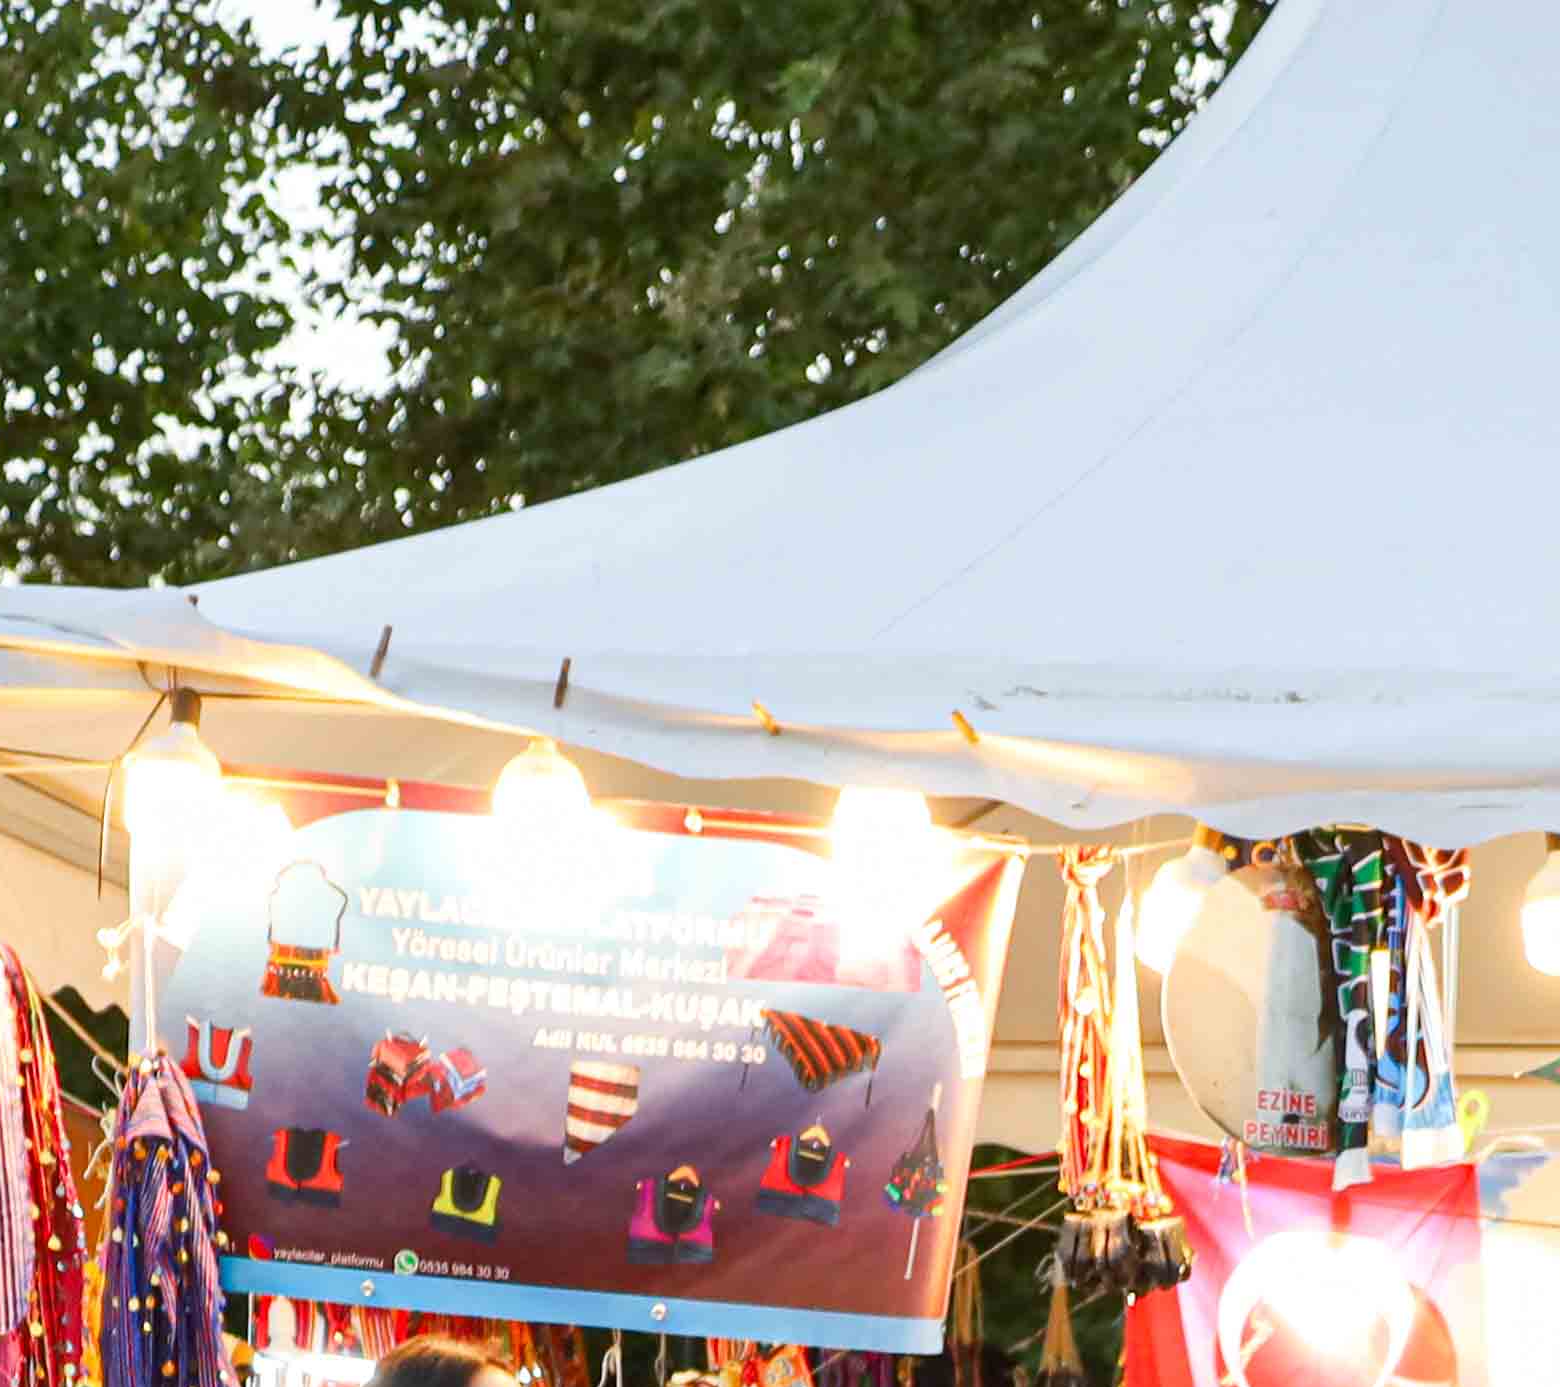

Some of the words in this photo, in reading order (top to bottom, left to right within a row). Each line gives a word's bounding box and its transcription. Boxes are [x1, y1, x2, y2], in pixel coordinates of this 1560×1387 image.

[712, 1042, 737, 1062] 30
[740, 1043, 766, 1065] 30
[1257, 1088, 1317, 1115] EZİNE
[1244, 1119, 1329, 1148] PEYNİRİ
[476, 1264, 491, 1279] 30
[494, 1265, 510, 1280] 30
